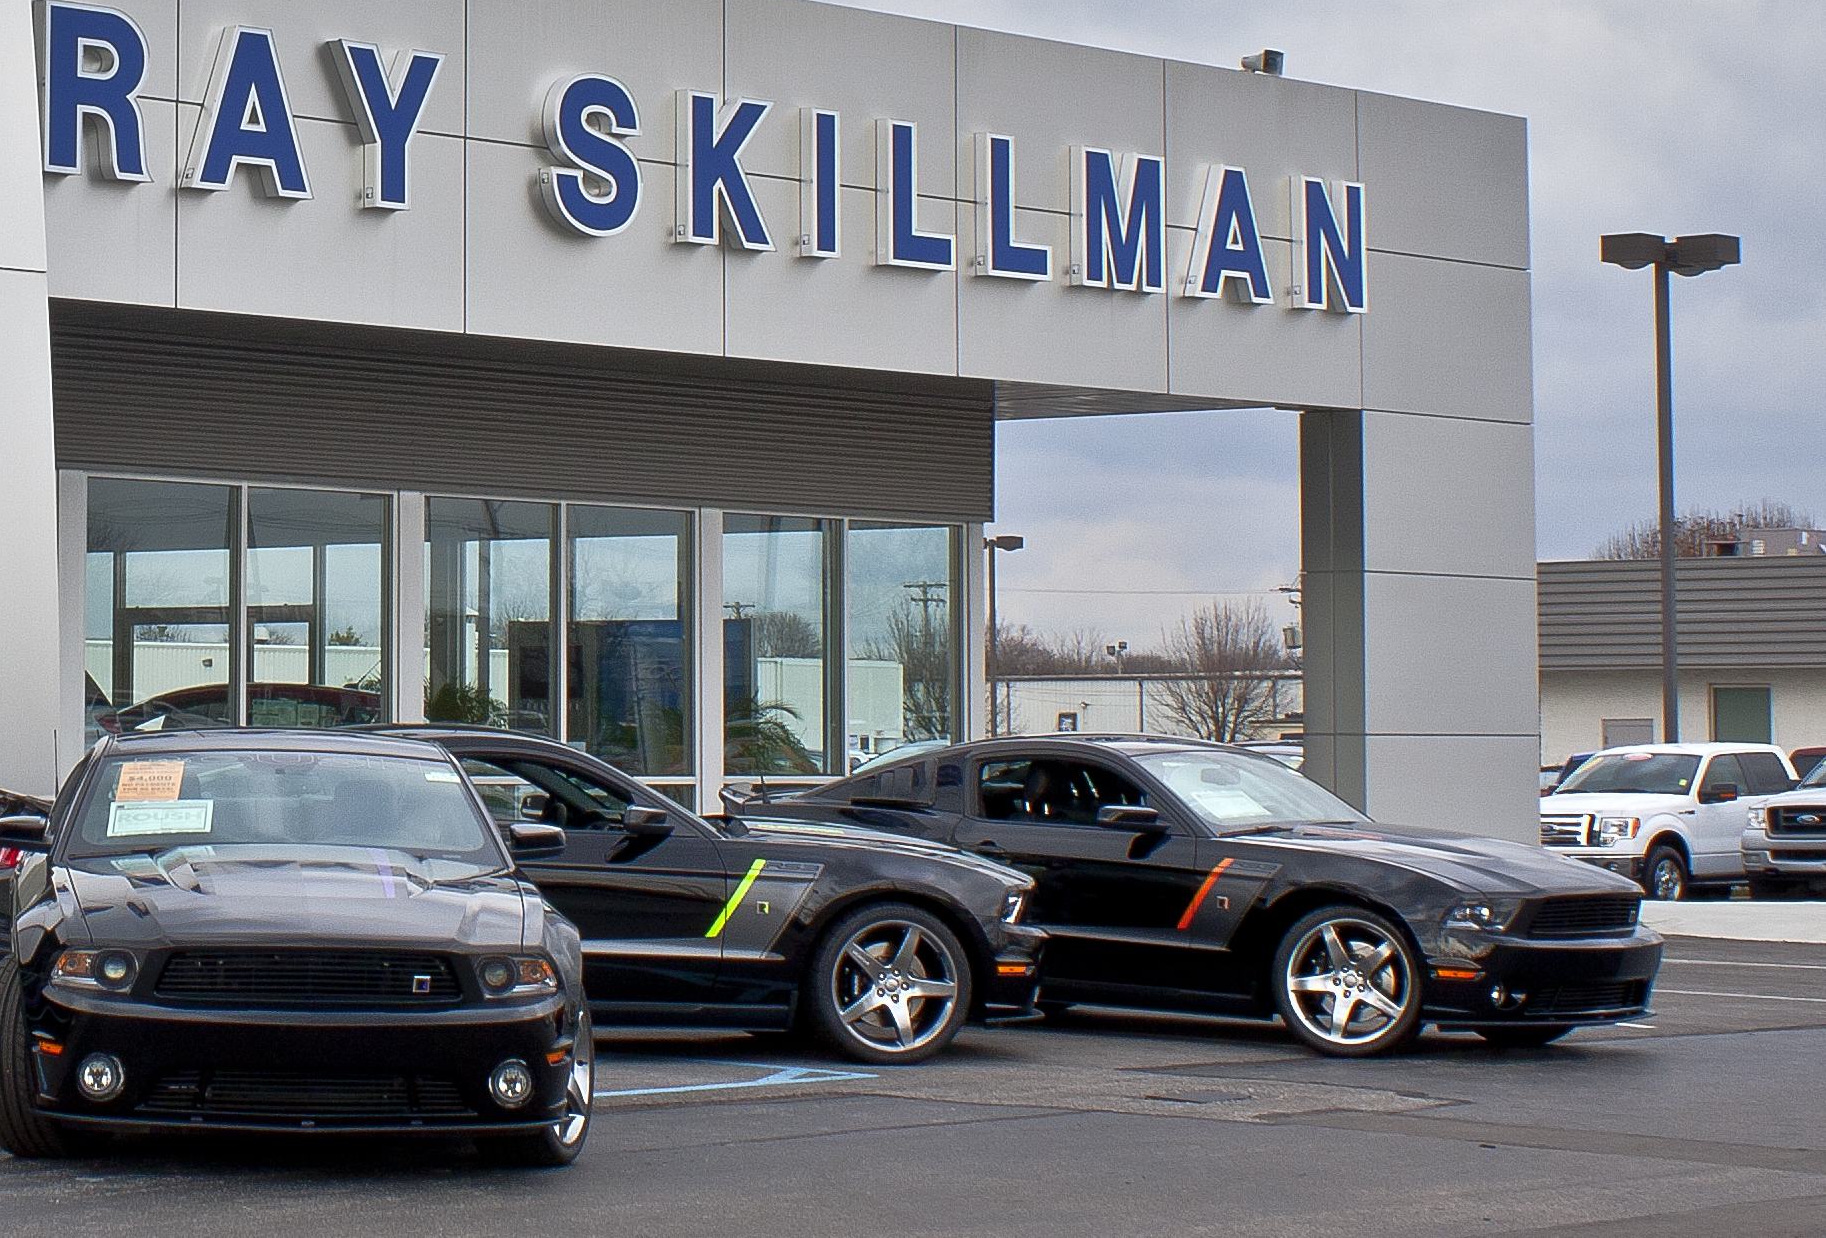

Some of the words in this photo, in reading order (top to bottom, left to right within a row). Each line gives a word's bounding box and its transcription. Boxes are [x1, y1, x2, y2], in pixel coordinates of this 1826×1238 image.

[36, 0, 446, 210] RAY
[540, 72, 1366, 314] SKILLMAN
[118, 811, 202, 822] ROUSH
